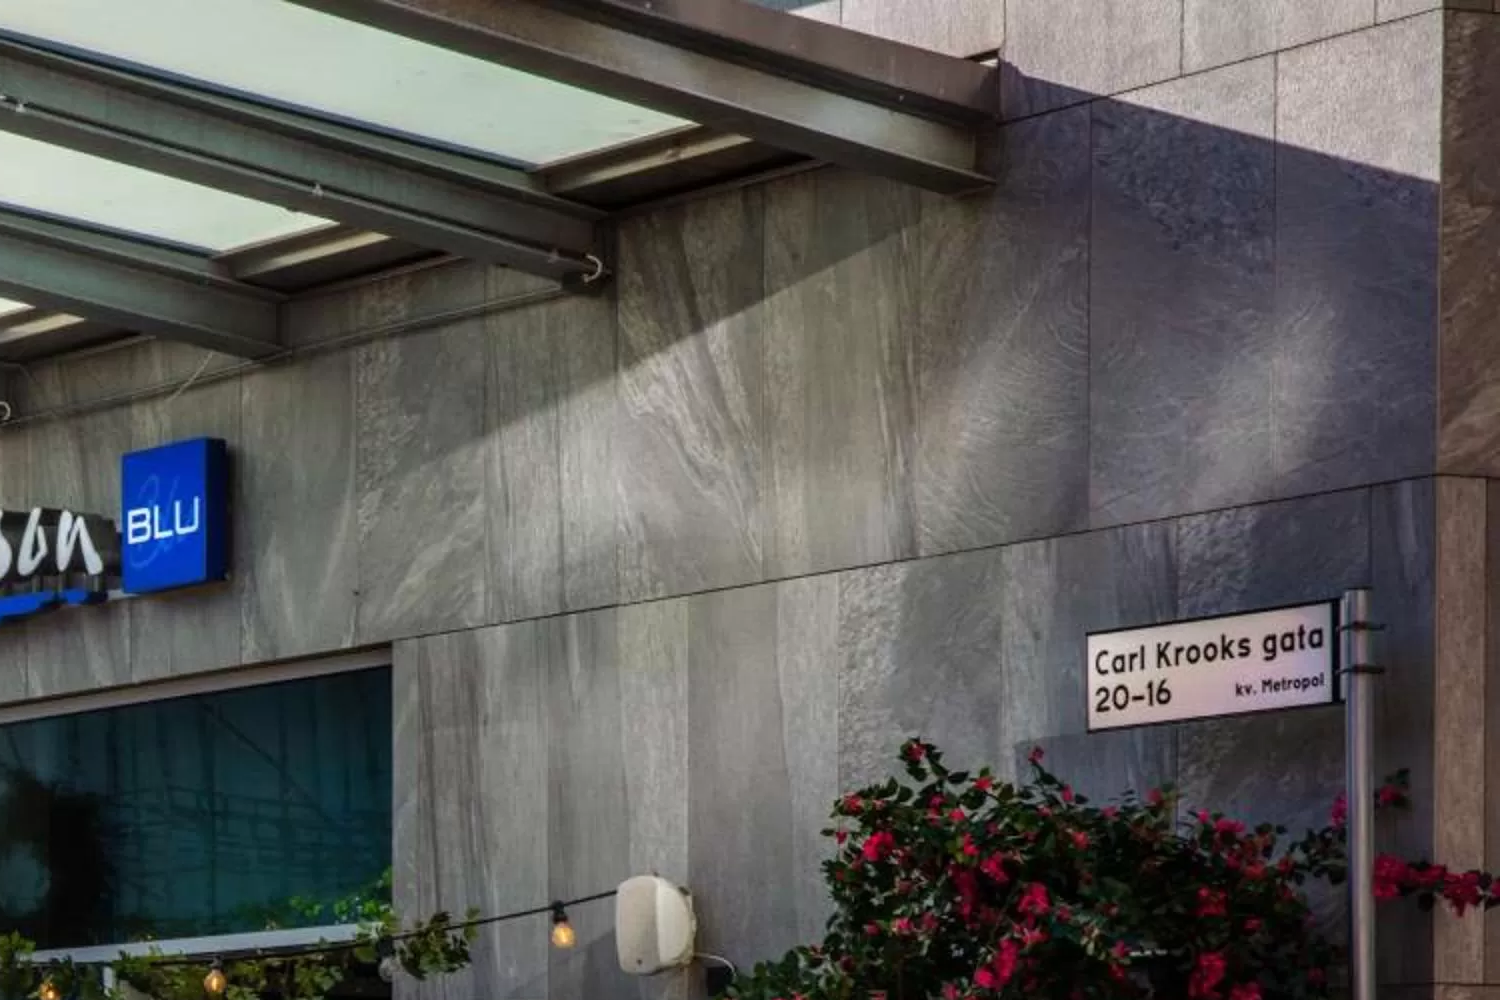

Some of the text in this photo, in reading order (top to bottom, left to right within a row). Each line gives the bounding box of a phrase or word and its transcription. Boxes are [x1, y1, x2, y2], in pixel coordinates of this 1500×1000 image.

[127, 496, 201, 545] BLU
[1095, 624, 1324, 676] Carl Krooks gata
[1095, 679, 1172, 713] 20-16
[1235, 672, 1325, 697] kv. Metropol
